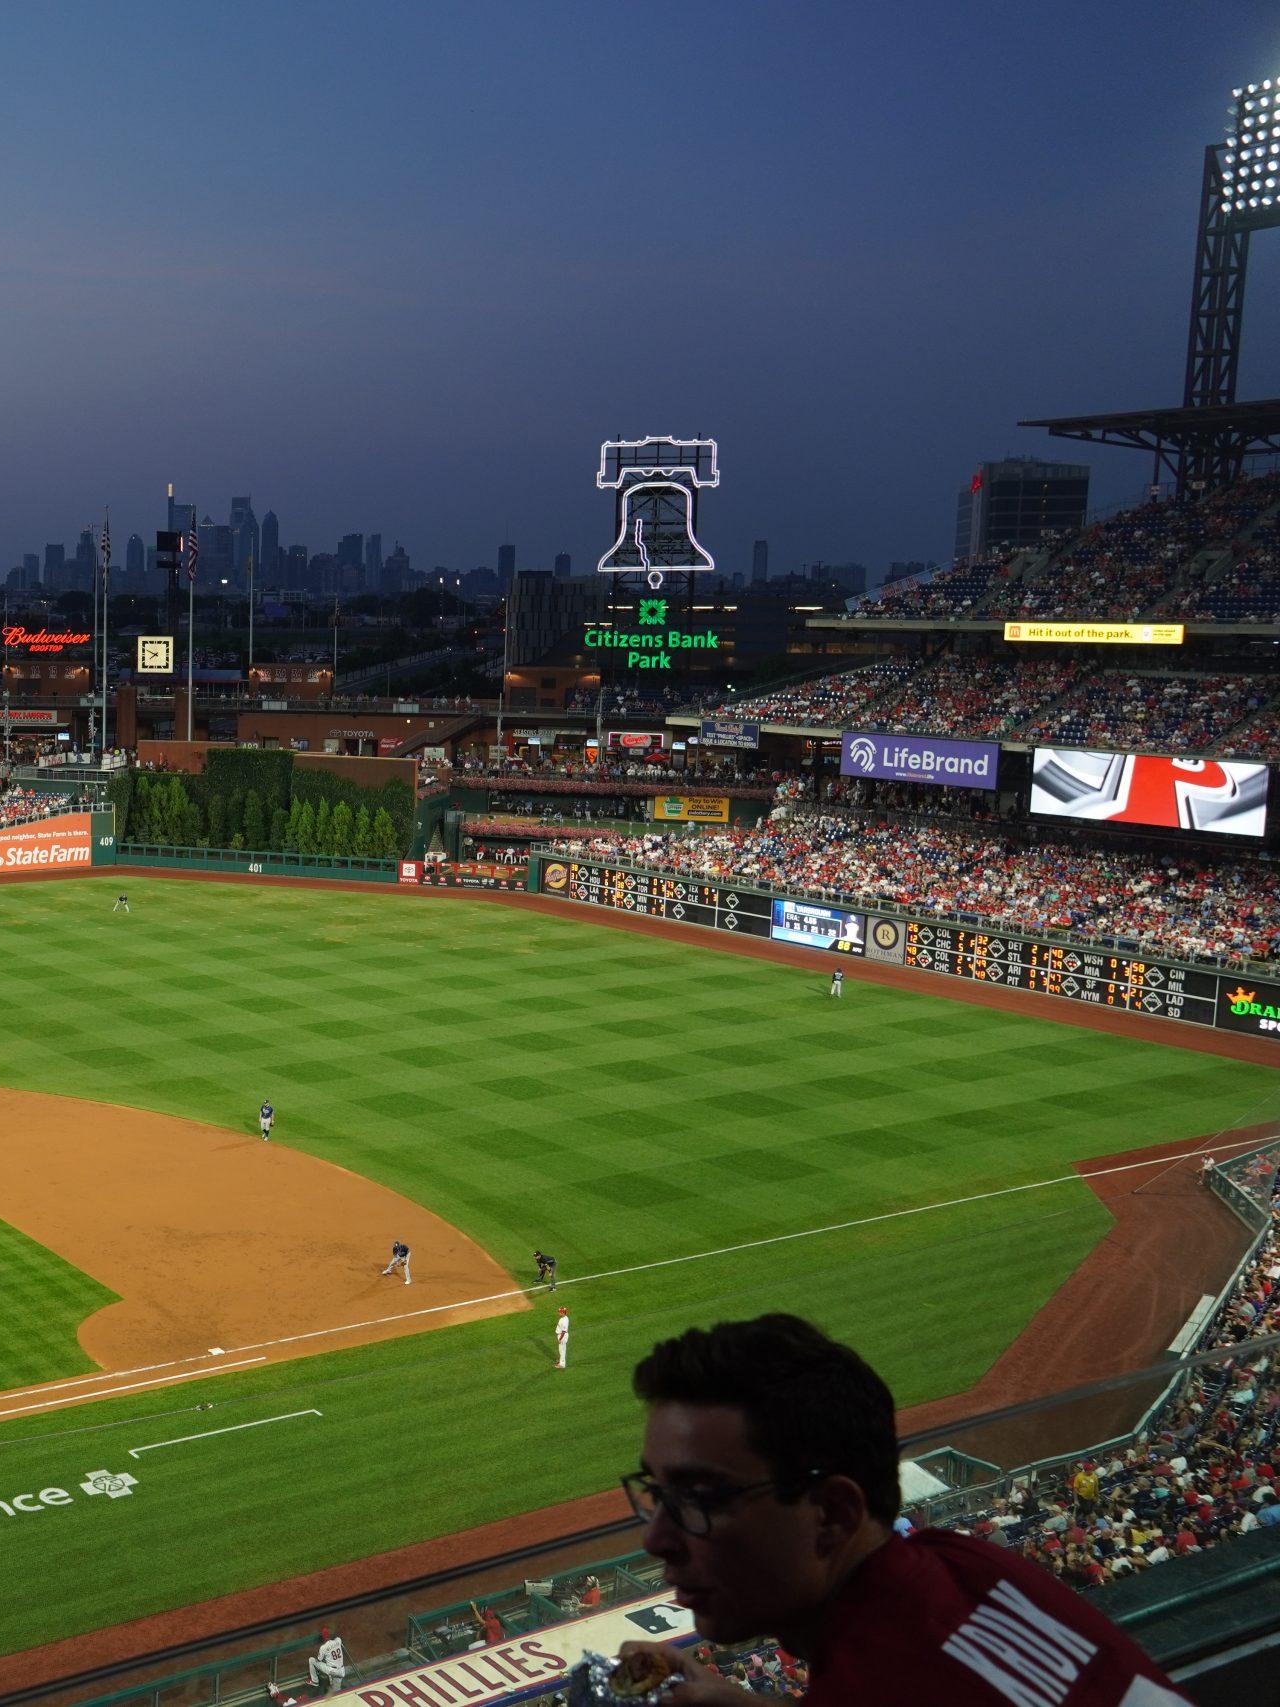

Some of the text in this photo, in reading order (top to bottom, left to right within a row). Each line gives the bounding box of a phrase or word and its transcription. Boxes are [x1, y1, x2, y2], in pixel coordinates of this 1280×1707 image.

[2, 627, 91, 645] Budweiser
[584, 630, 719, 649] Citizens Bank
[1028, 628, 1133, 640] Hit it out of the park.
[628, 651, 671, 669] Park
[342, 729, 375, 738] TOYOTA
[883, 747, 989, 776] LifeBrand
[100, 837, 114, 846] 409
[248, 863, 263, 873] 401
[589, 876, 600, 884] HOU
[637, 885, 648, 893] TOR
[688, 885, 699, 894] TEX
[687, 894, 699, 903] CLE
[636, 904, 647, 913] BOS
[786, 913, 800, 922] ERA:
[882, 929, 890, 940] R
[908, 923, 964, 941] 26 COL 2
[909, 935, 975, 952] 12 CHC 5 F
[977, 935, 1038, 954] 32 DET 2
[935, 951, 949, 962] COL
[957, 956, 963, 964] 2
[976, 946, 1049, 966] 62 STL 3 F
[1051, 949, 1117, 968] 40 WSH 0
[906, 956, 962, 975] 35 CHC 5
[1007, 965, 1021, 975] ARI
[1030, 969, 1036, 978] 0
[1084, 966, 1130, 977] MIA 3
[1132, 962, 1185, 980] 58 CIN
[1007, 976, 1020, 986] PIT
[1029, 980, 1035, 989] 0
[1043, 977, 1048, 986] 3
[1085, 979, 1096, 989] SF
[1108, 983, 1115, 993] 0
[1131, 975, 1184, 993] 53 MIL
[1081, 990, 1100, 1002] NYM
[1107, 995, 1114, 1004] 0
[1121, 992, 1128, 1001] 4
[1129, 988, 1184, 1006] 21 LAD
[1167, 1007, 1181, 1018] SD
[941, 1579, 1098, 1707] KRUK
[331, 1649, 342, 1661] 82
[357, 1641, 568, 1707] PHILLIES
